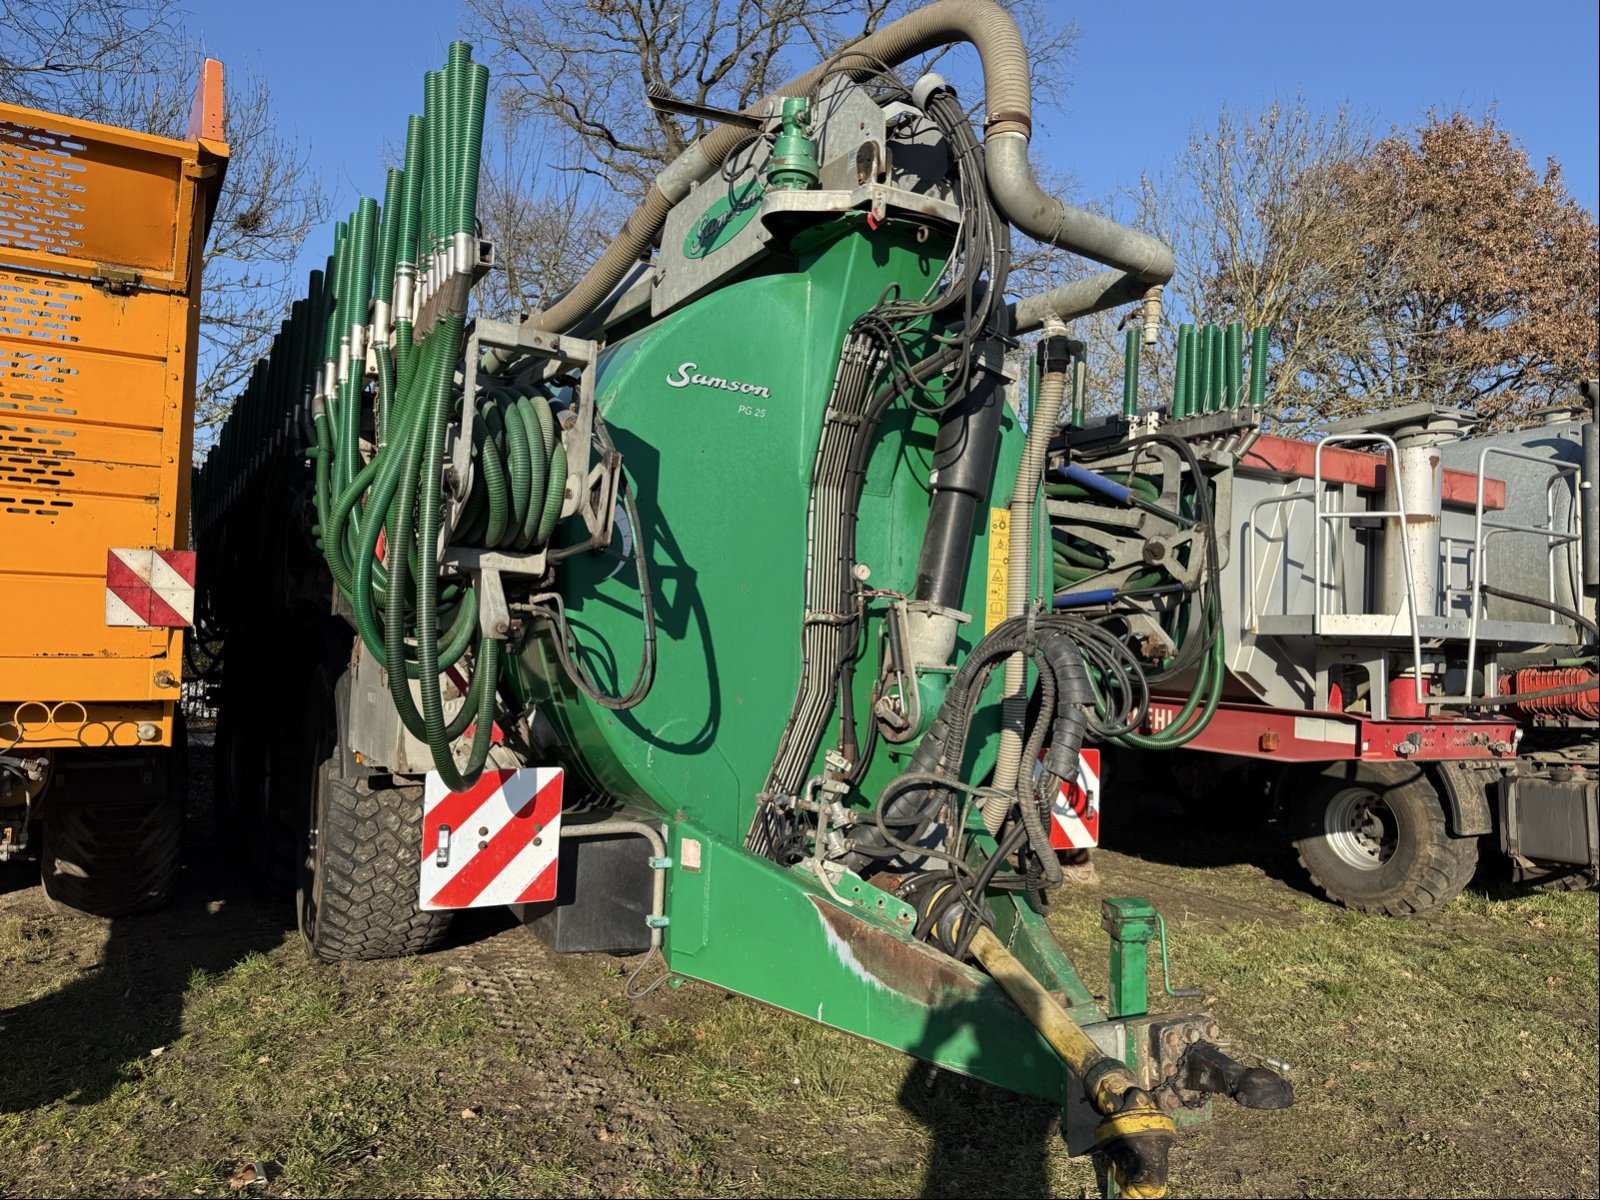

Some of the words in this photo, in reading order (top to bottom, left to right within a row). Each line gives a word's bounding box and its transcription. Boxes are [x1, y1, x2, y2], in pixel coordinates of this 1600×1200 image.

[666, 362, 771, 398] Samson
[738, 405, 752, 415] PG
[754, 408, 766, 418] 25
